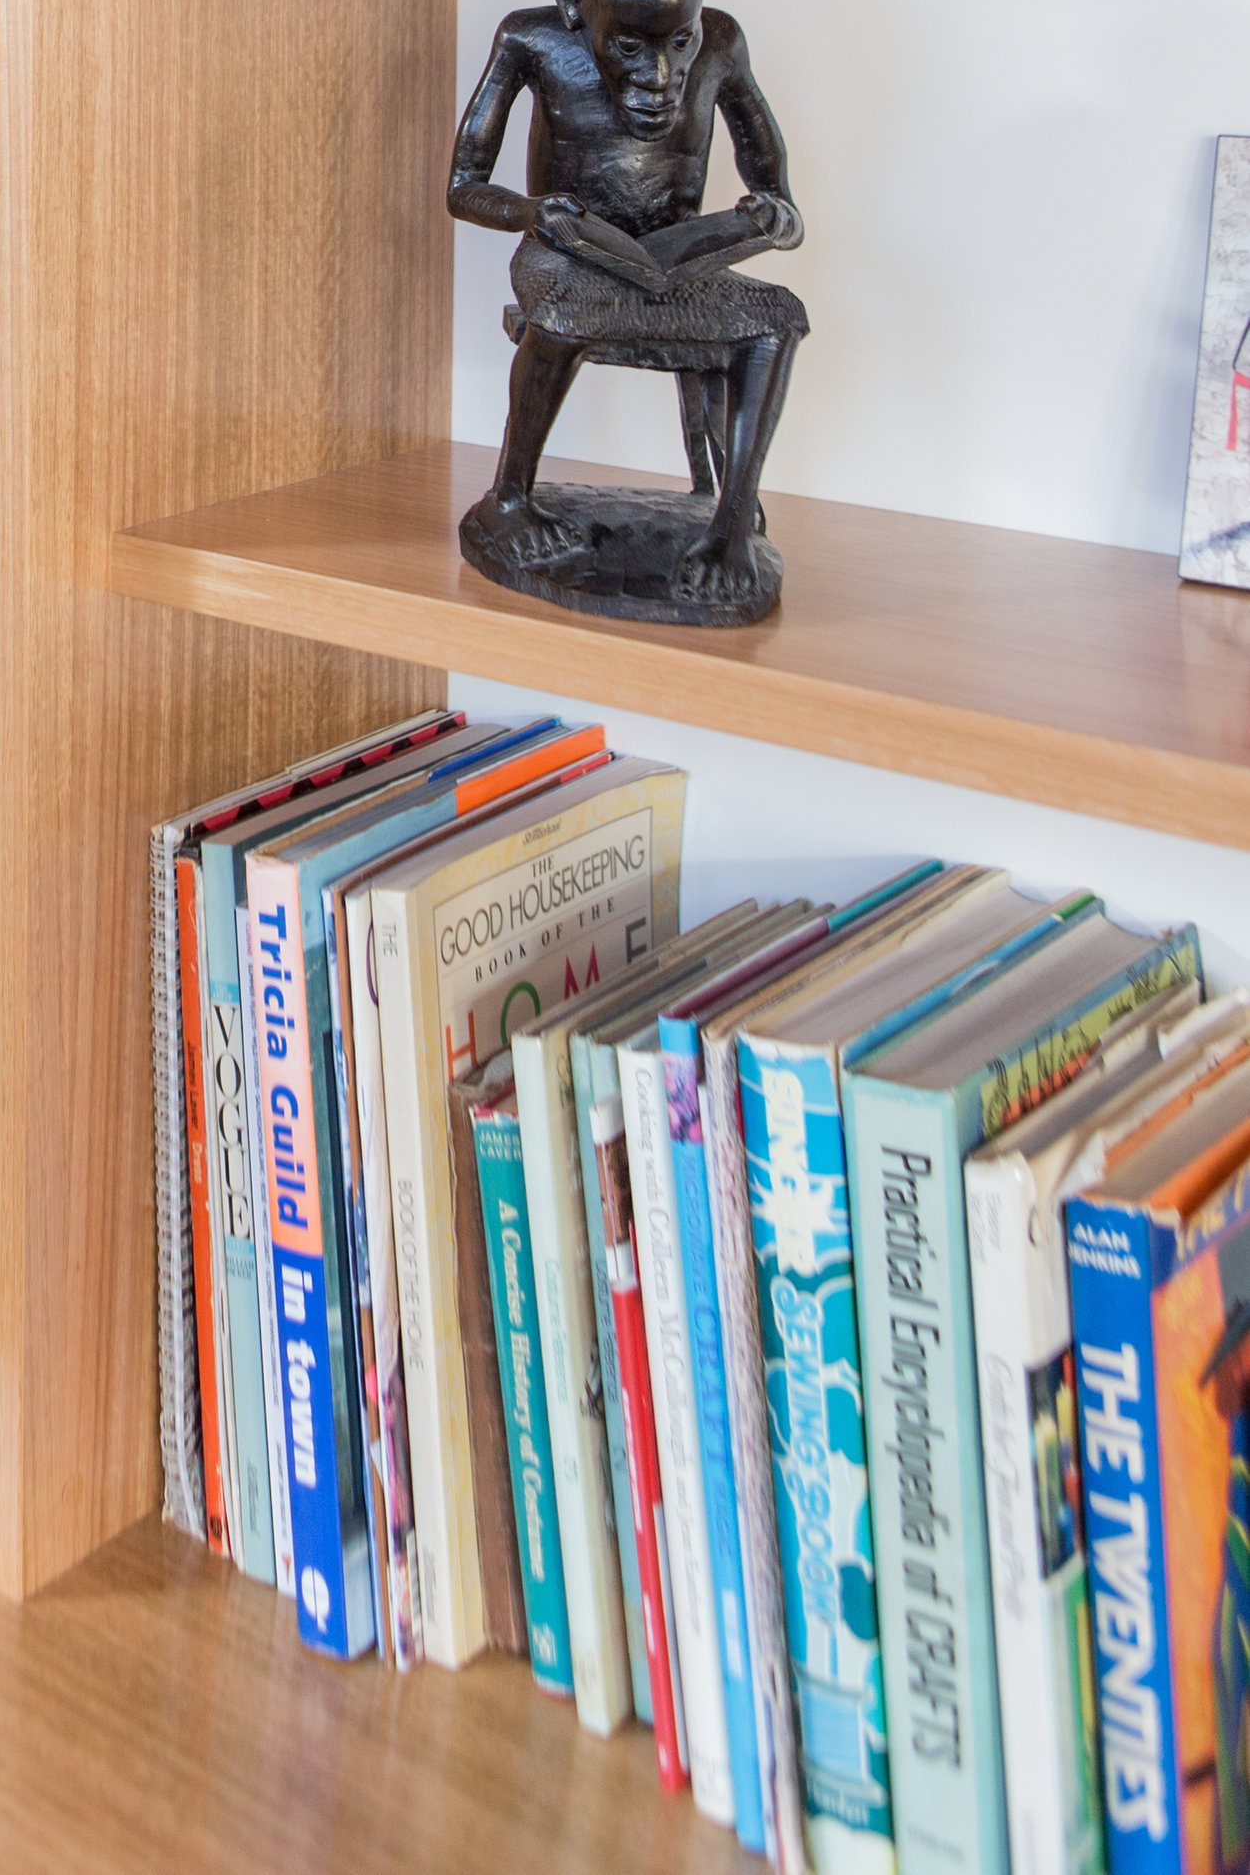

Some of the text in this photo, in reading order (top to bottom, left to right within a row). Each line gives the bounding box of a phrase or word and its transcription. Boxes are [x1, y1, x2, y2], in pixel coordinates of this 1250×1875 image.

[381, 920, 399, 959] THE
[439, 834, 646, 967] GOOD HOUSEKEEPING
[474, 895, 617, 984] BOOK OF THE
[530, 853, 555, 878] THE
[257, 904, 295, 1063] Tricia
[186, 1039, 197, 1091] James
[188, 1091, 199, 1131] Laver
[213, 1003, 251, 1241] VOGUE
[478, 1129, 520, 1145] JAMES
[269, 1084, 309, 1232] Guild
[478, 1143, 522, 1163] LAVER
[634, 1067, 654, 1151] Cooking
[648, 1207, 671, 1303] Colleen
[761, 1064, 815, 1277] SINGER
[879, 1143, 940, 1313] Practical
[396, 1178, 424, 1373] BOOK OF THE HOME
[1068, 1240, 1142, 1281] JENKINS
[1072, 1220, 1132, 1254] ALAN
[281, 1262, 319, 1489] in town
[498, 1197, 546, 1584] A Concise History of Costume
[694, 1305, 729, 1475] CRAFT
[880, 1312, 952, 1551] Encyclopedia
[902, 1556, 956, 1613] of
[1079, 1340, 1170, 1845] THE TWENTIES
[904, 1606, 964, 1775] CRAFTS
